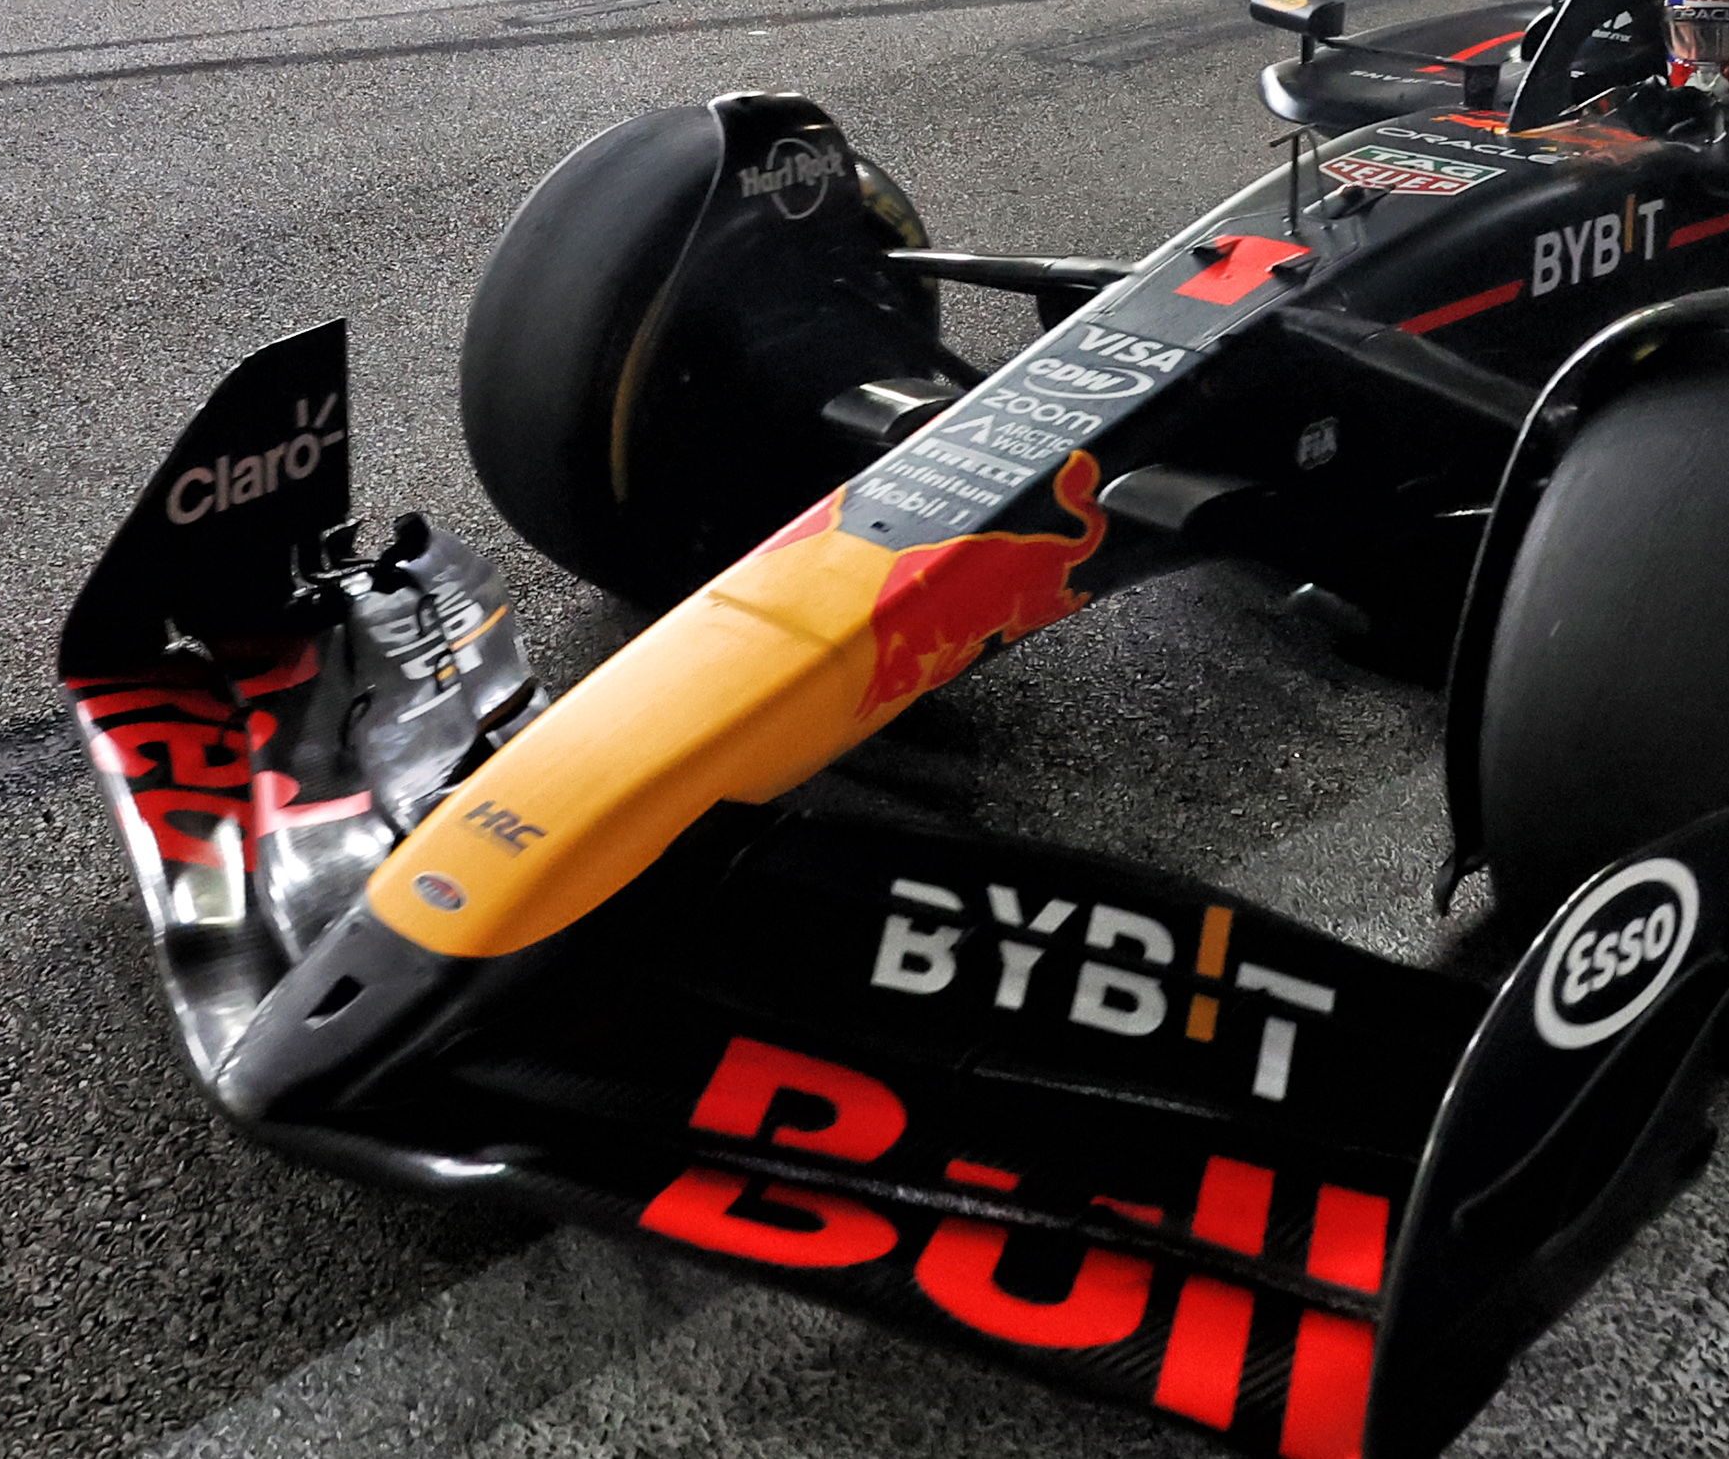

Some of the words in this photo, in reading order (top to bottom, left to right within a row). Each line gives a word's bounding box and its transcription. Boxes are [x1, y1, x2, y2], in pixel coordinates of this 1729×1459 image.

[1370, 149, 1484, 179] TAG
[1376, 127, 1569, 164] ORACLE
[737, 155, 792, 199] Hard
[1332, 159, 1465, 191] HEUER
[1531, 193, 1665, 298] BYBIT
[1174, 235, 1313, 305] 1
[1076, 327, 1188, 373] VISA
[1027, 357, 1127, 391] CDW
[980, 387, 1105, 435] zoom
[991, 434, 1054, 461] WOLF
[994, 421, 1075, 453] ARCTIC
[166, 433, 321, 526] Claro
[856, 477, 949, 519] Mobil
[948, 509, 970, 526] 1
[464, 799, 550, 855] HRC
[872, 878, 1335, 1101] BYBIT
[638, 1036, 1391, 1459] Bull
